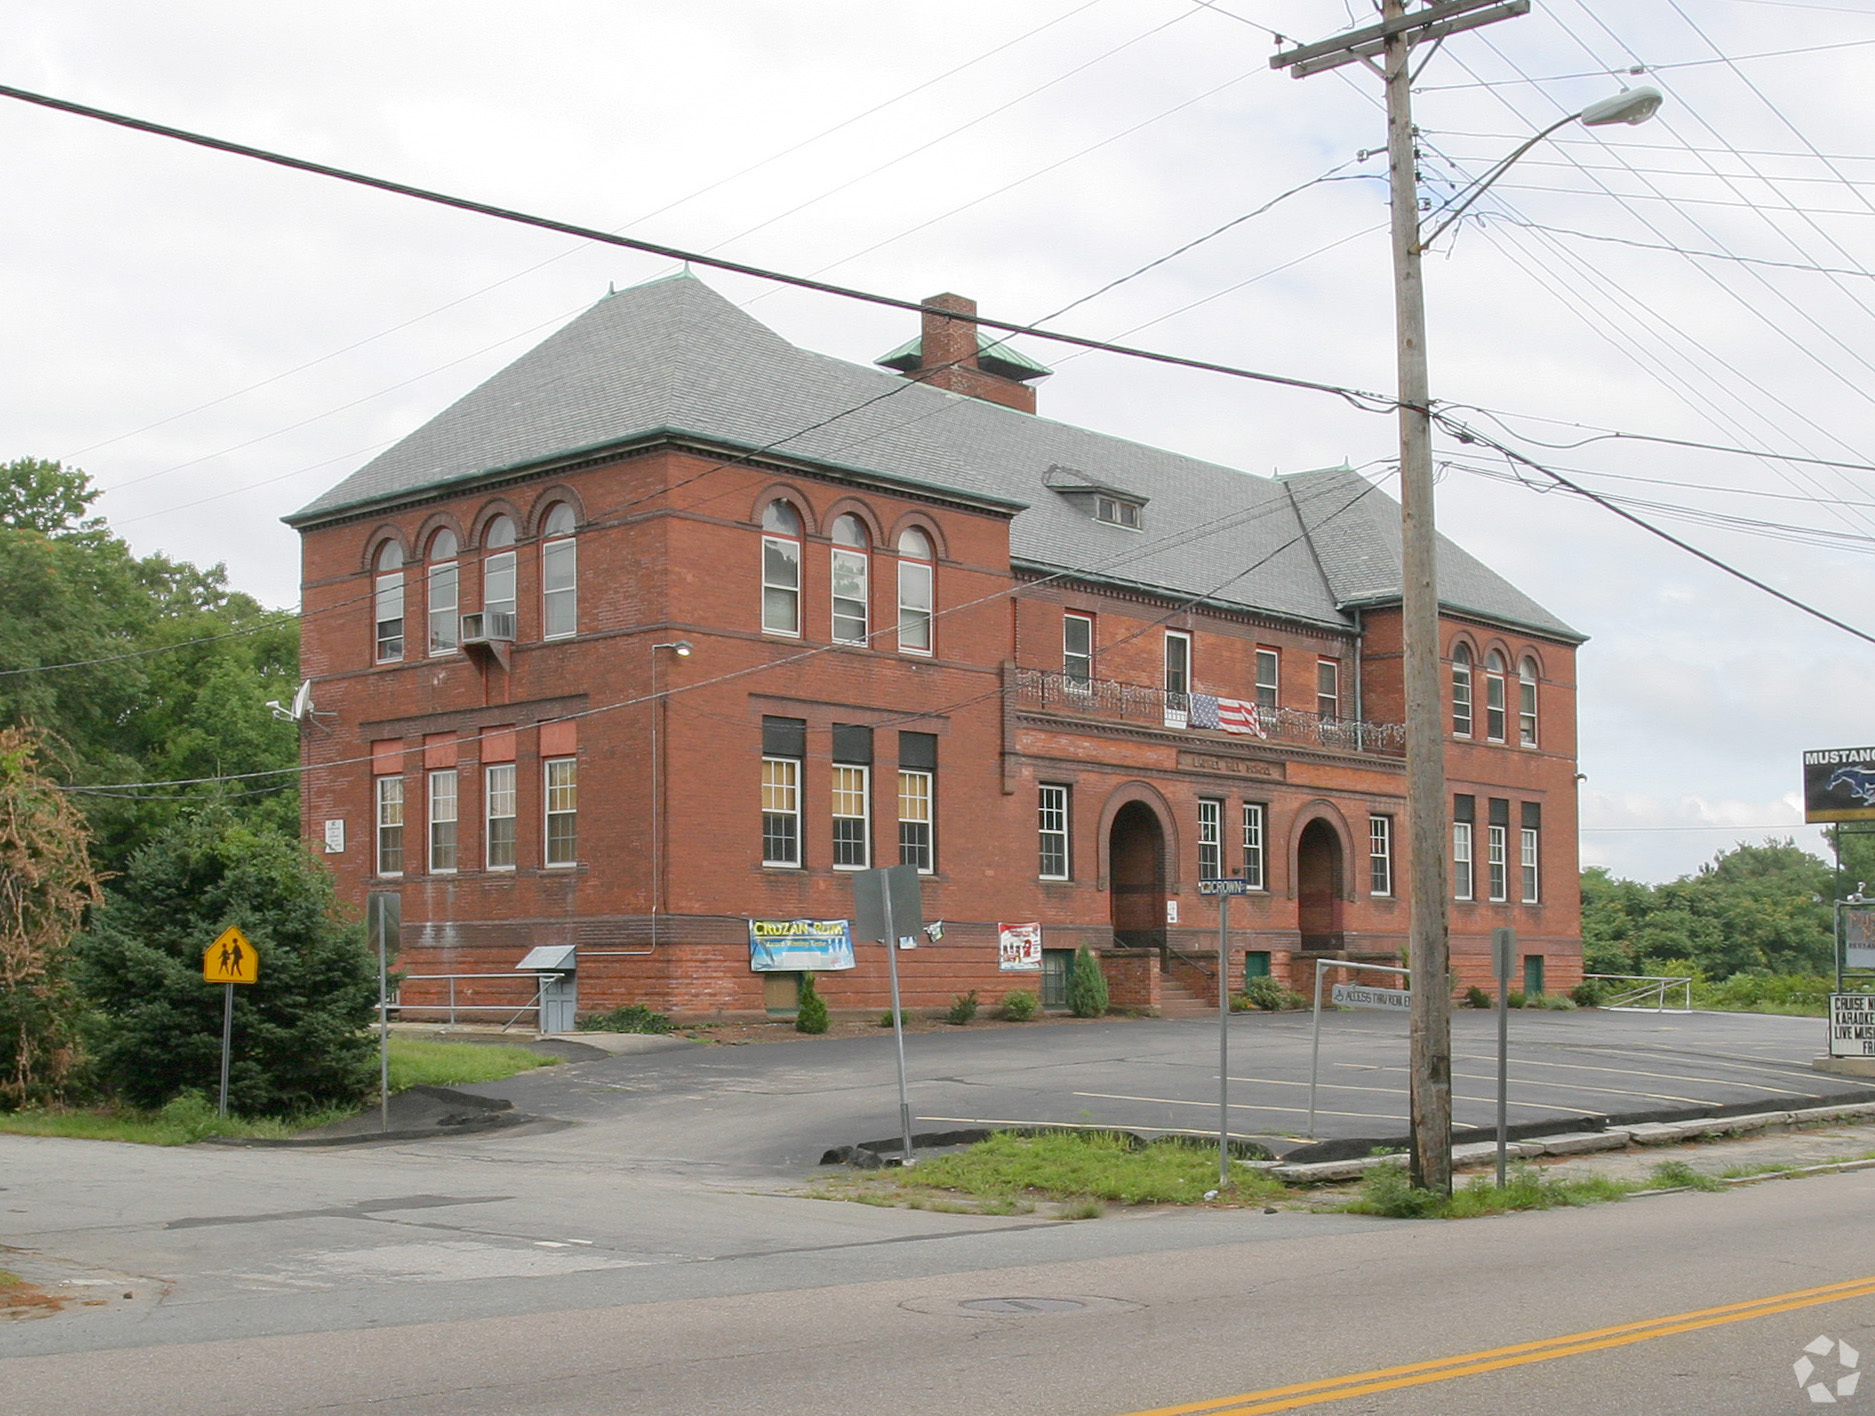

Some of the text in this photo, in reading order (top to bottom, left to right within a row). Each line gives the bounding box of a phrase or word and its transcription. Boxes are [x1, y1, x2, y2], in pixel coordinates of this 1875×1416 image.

[1211, 881, 1241, 893] CROWN
[753, 921, 843, 936] CRUZAN RUM
[1345, 991, 1372, 1003] ACCESS
[1372, 992, 1388, 1005] THRU
[1834, 997, 1865, 1011] CRUISE
[1834, 1012, 1875, 1025] KARAOKE
[1834, 1026, 1853, 1039] LIVE
